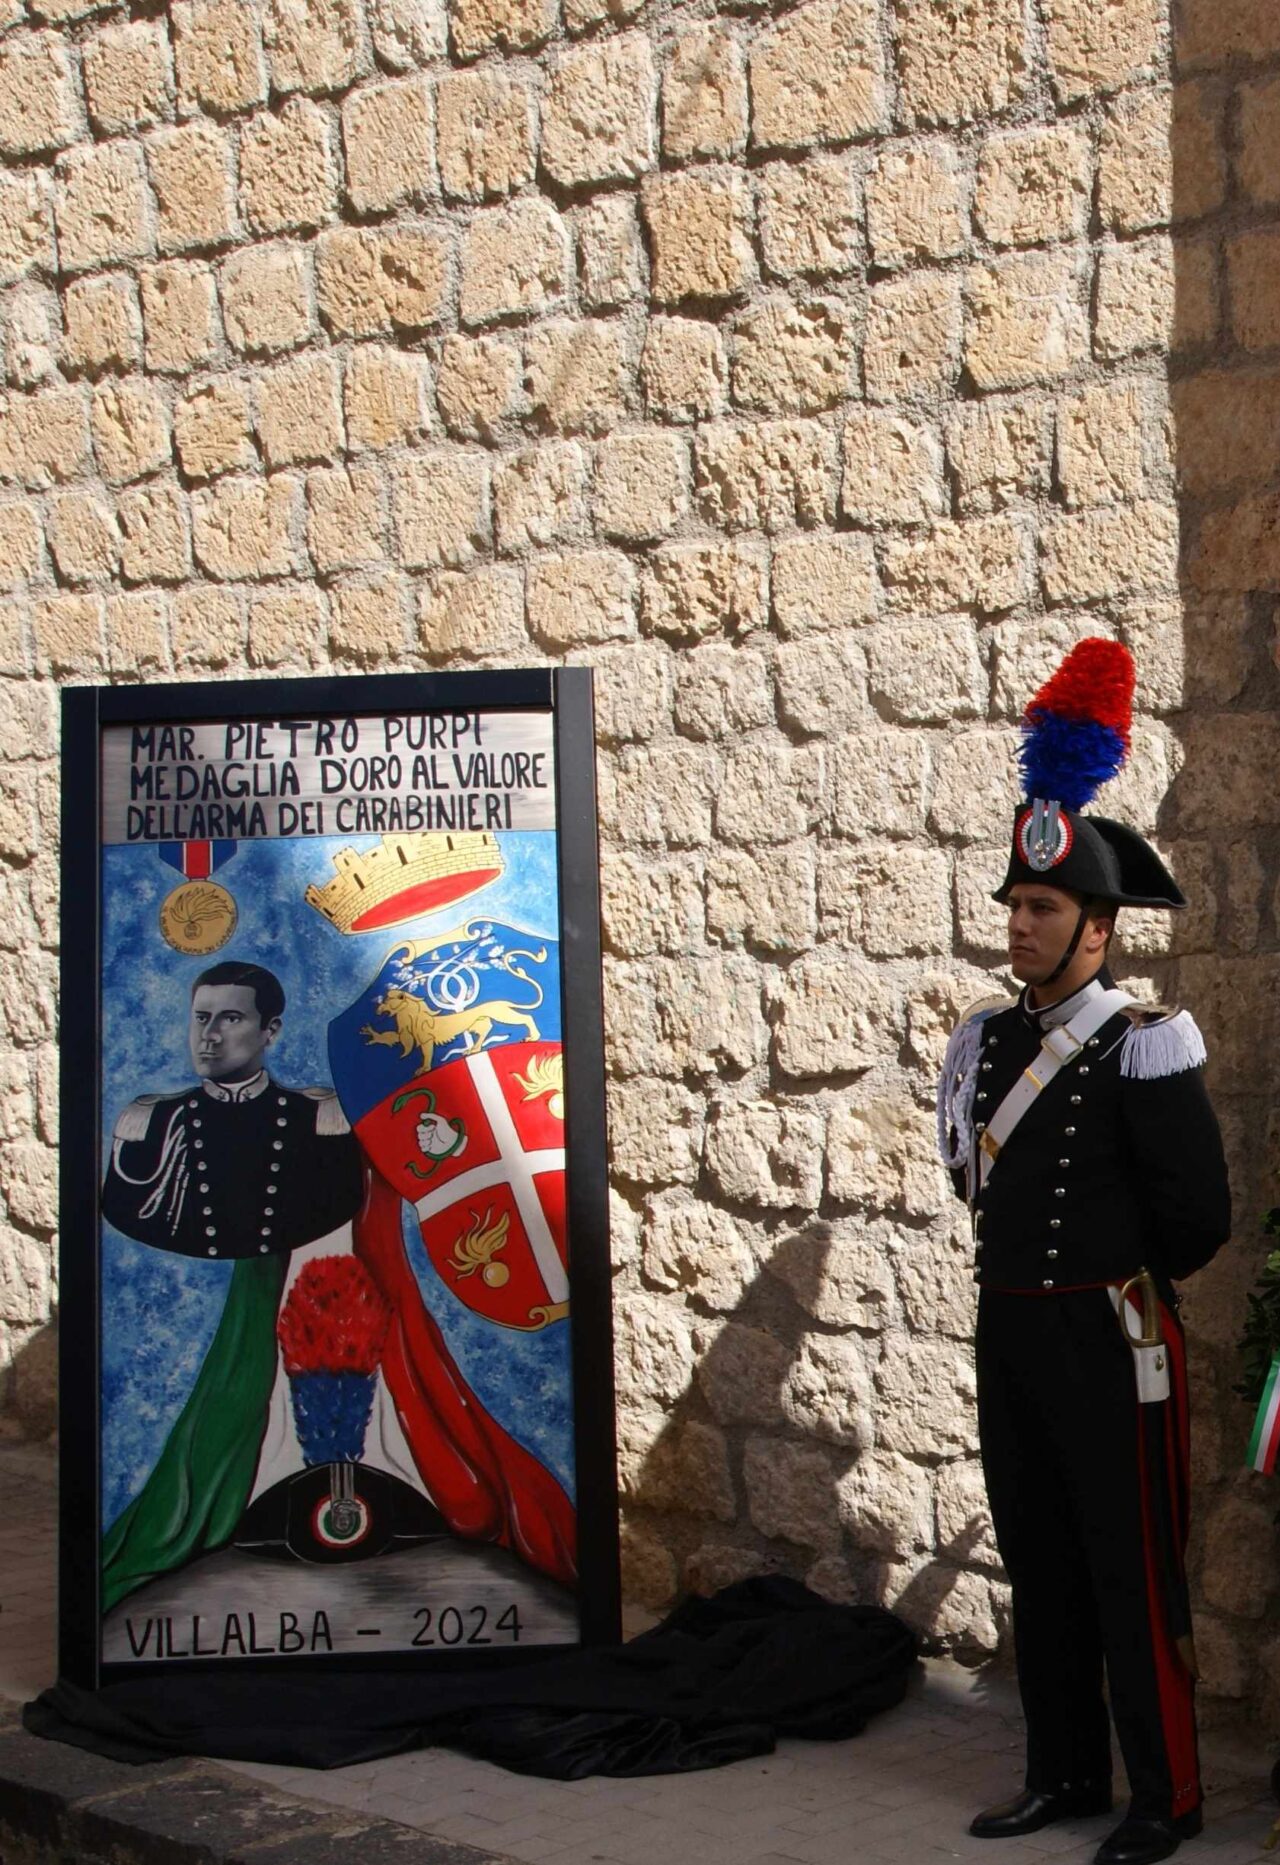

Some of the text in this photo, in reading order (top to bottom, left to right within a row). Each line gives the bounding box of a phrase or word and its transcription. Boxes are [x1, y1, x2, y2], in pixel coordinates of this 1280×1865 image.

[130, 713, 482, 762] MAR. PIETRO PURPI
[130, 752, 548, 801] MEDAGLIA D'ORO AL VALORE
[126, 793, 513, 841] DELL'ARMA DEI CARABINIERI
[126, 1610, 333, 1658] VILLALBA
[411, 1604, 524, 1647] 2024
